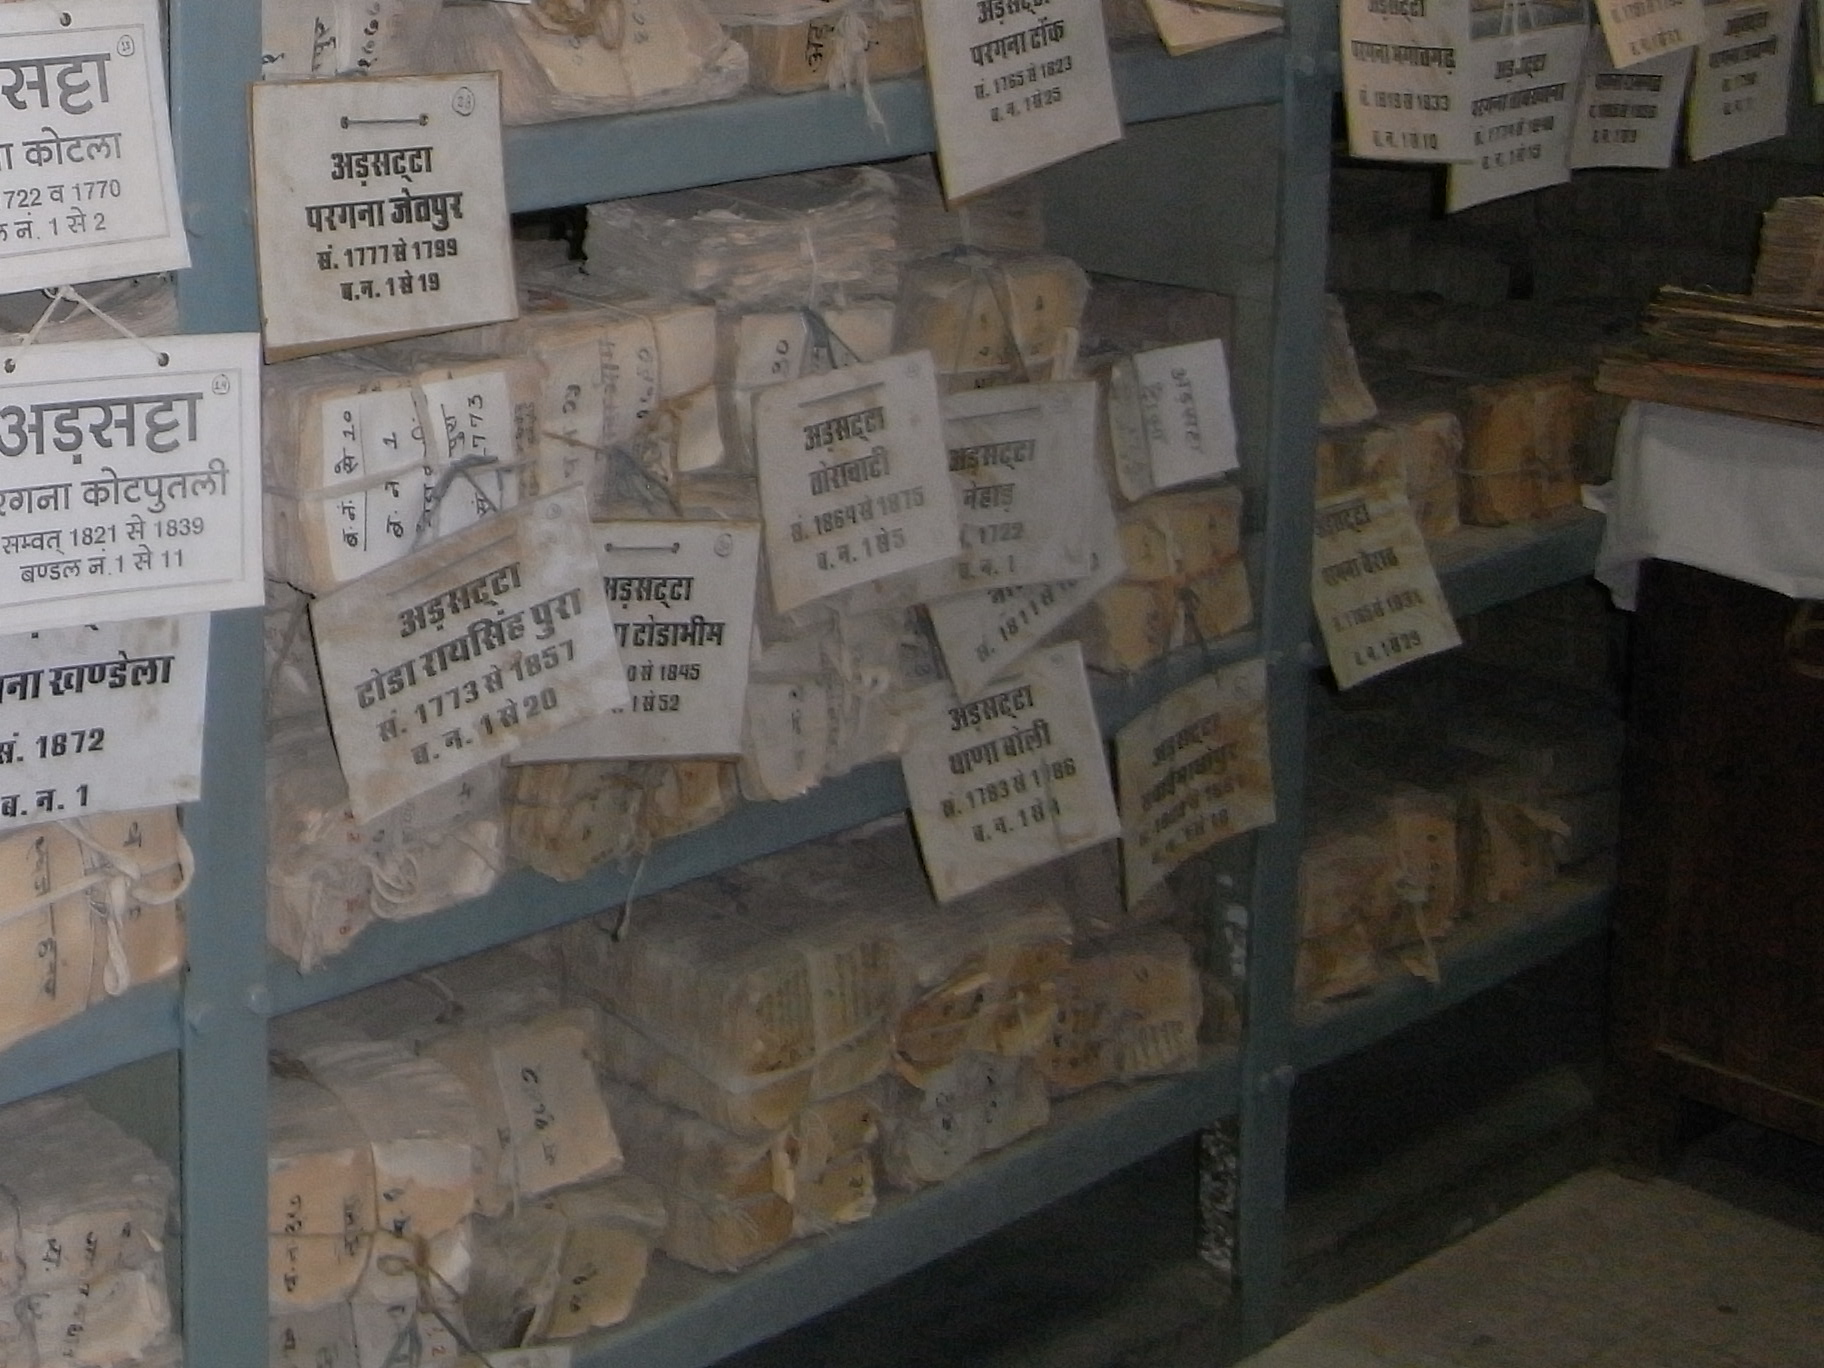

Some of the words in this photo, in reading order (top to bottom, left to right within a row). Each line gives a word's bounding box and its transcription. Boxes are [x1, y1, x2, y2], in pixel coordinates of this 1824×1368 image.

[970, 30, 1027, 67] परगना
[23, 127, 121, 167] कोटला
[331, 146, 433, 186] अड़सट्टा
[48, 185, 65, 203] व
[71, 180, 121, 202] 1770
[306, 200, 385, 232] परगना
[317, 245, 338, 270] सं.
[344, 245, 388, 266] 1777
[392, 237, 407, 262] से
[412, 238, 457, 259] 1799
[81, 458, 229, 514] कोटपुतली
[1, 530, 64, 555] सम्वत्
[68, 524, 118, 548] 1821
[126, 515, 147, 541] से
[153, 517, 205, 538] 1839
[397, 562, 522, 639] अड़सट्टा
[354, 657, 416, 710] टोडा
[529, 587, 581, 641] पुरा
[632, 616, 725, 648] टोडाभीम
[49, 650, 175, 696] खण्डेला
[414, 681, 480, 726] 1773
[482, 665, 505, 693] से
[511, 639, 575, 681] 1857
[660, 663, 700, 680] 1845
